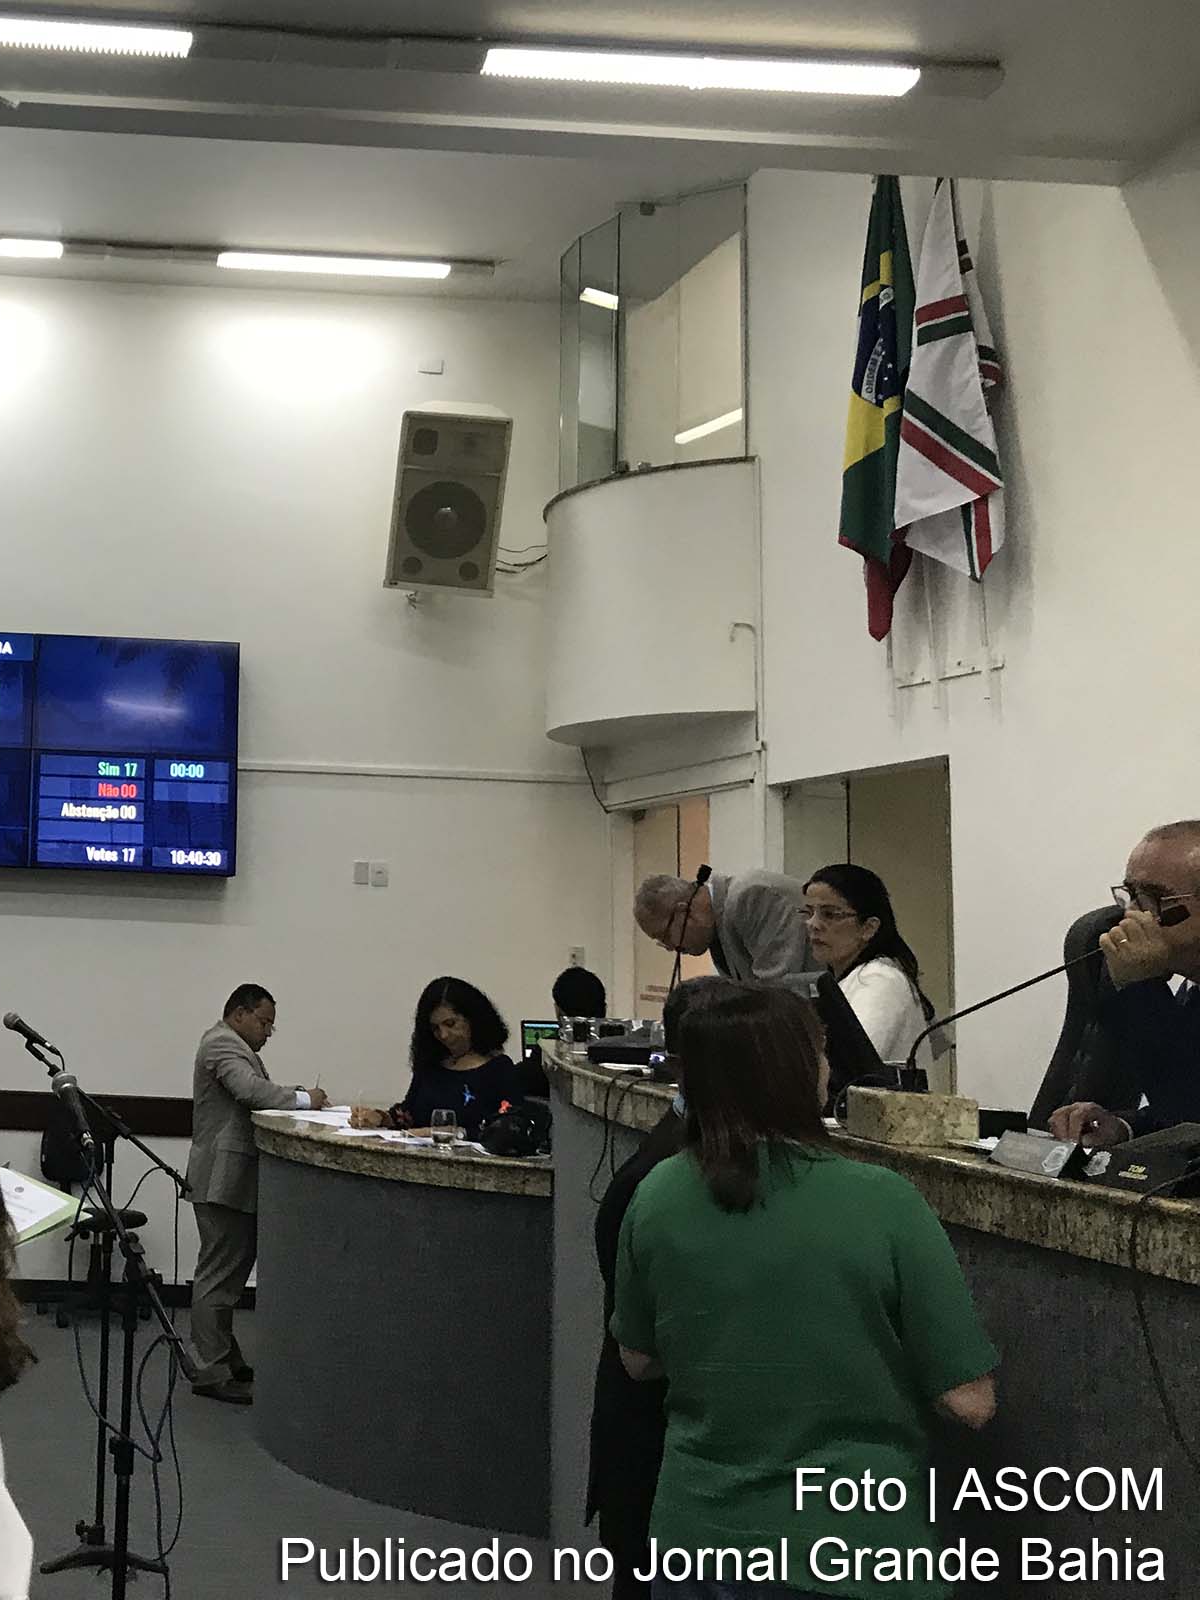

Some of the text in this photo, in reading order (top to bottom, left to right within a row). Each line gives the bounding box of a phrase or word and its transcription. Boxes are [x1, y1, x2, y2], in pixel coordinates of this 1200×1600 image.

[98, 762, 137, 777] Sim 17
[170, 763, 204, 777] 00:00
[98, 783, 136, 798] Não 00
[61, 803, 136, 821] Abstenção 00
[122, 848, 135, 863] 17
[170, 850, 221, 865] 10:40:30
